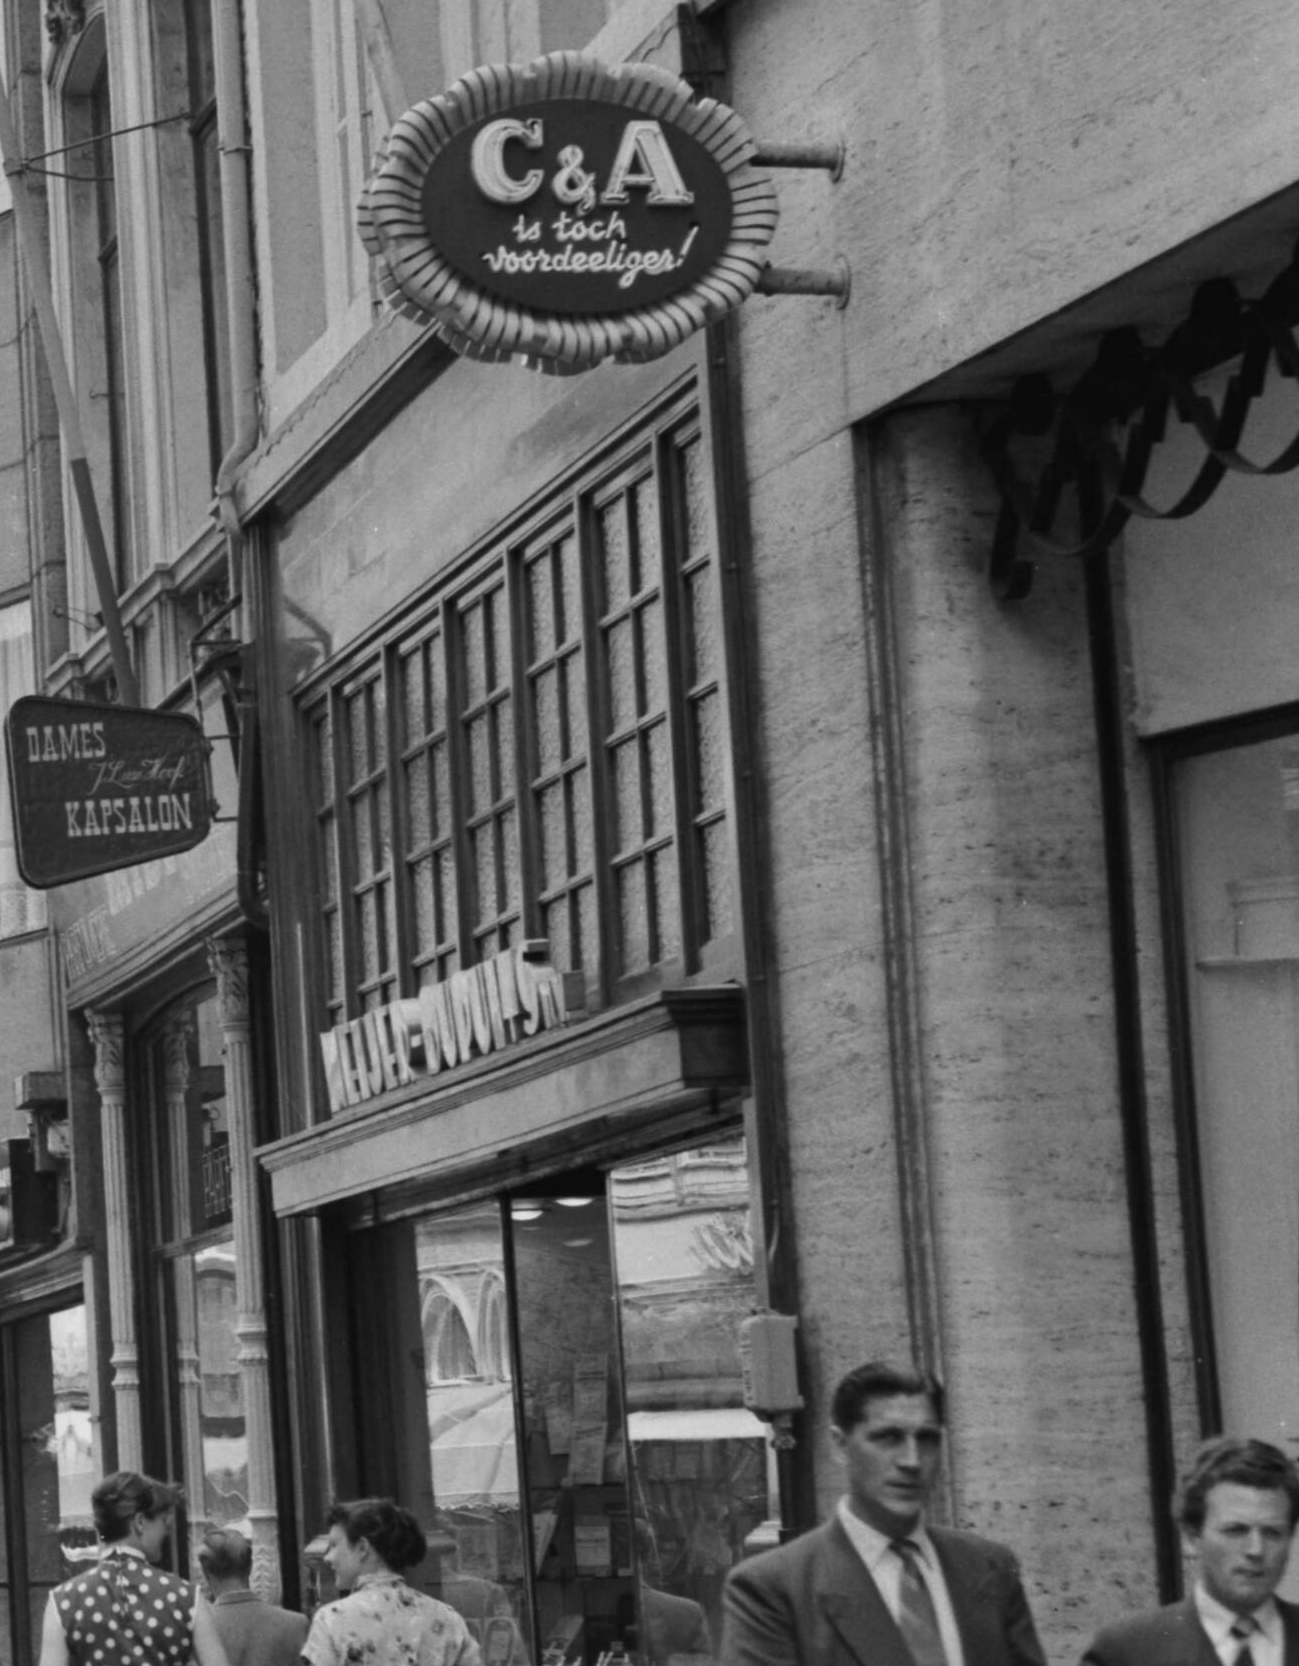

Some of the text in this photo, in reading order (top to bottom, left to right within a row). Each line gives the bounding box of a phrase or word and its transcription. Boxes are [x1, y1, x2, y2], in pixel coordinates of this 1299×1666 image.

[470, 117, 696, 217] C&A
[511, 210, 627, 243] is toch
[482, 224, 700, 290] voordeeliger!
[26, 721, 106, 763] DAMES
[64, 792, 193, 838] KAPSALON
